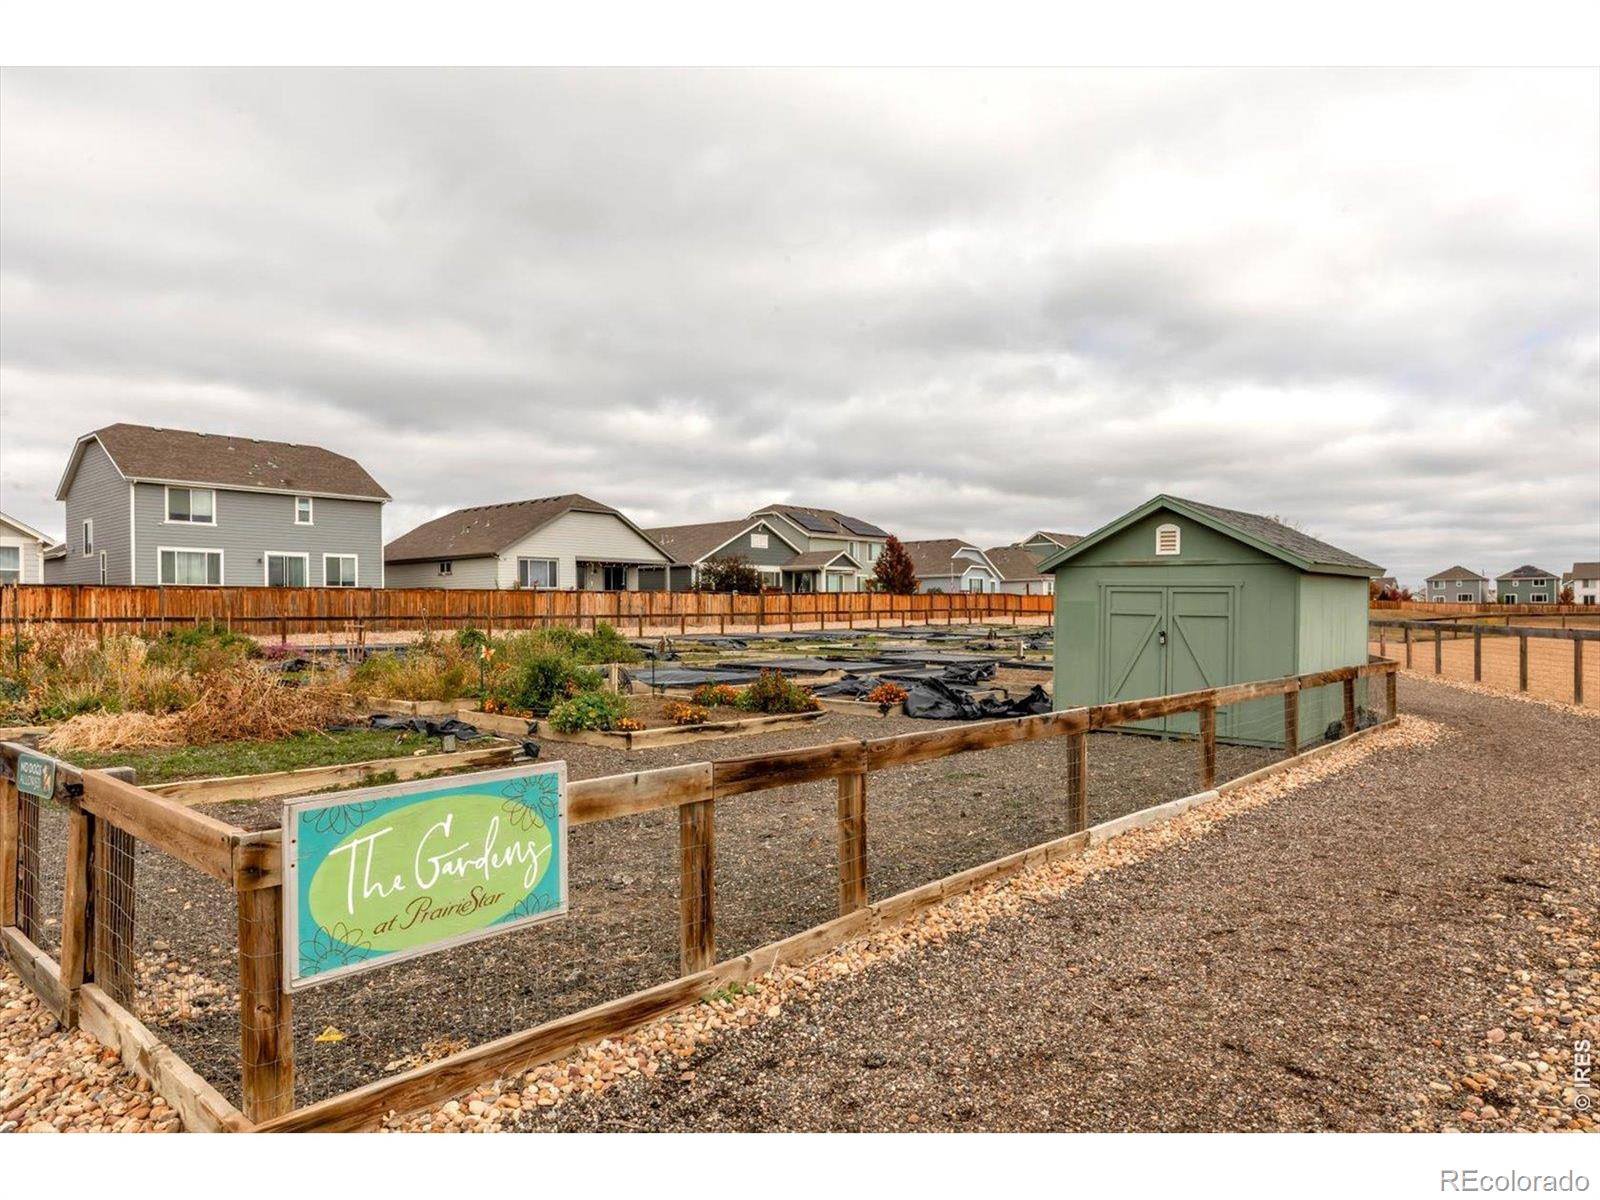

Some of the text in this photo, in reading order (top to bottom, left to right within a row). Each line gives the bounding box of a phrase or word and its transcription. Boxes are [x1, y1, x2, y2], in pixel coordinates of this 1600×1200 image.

[328, 813, 553, 914] The Gardens
[372, 885, 505, 935] at PrairieStar
